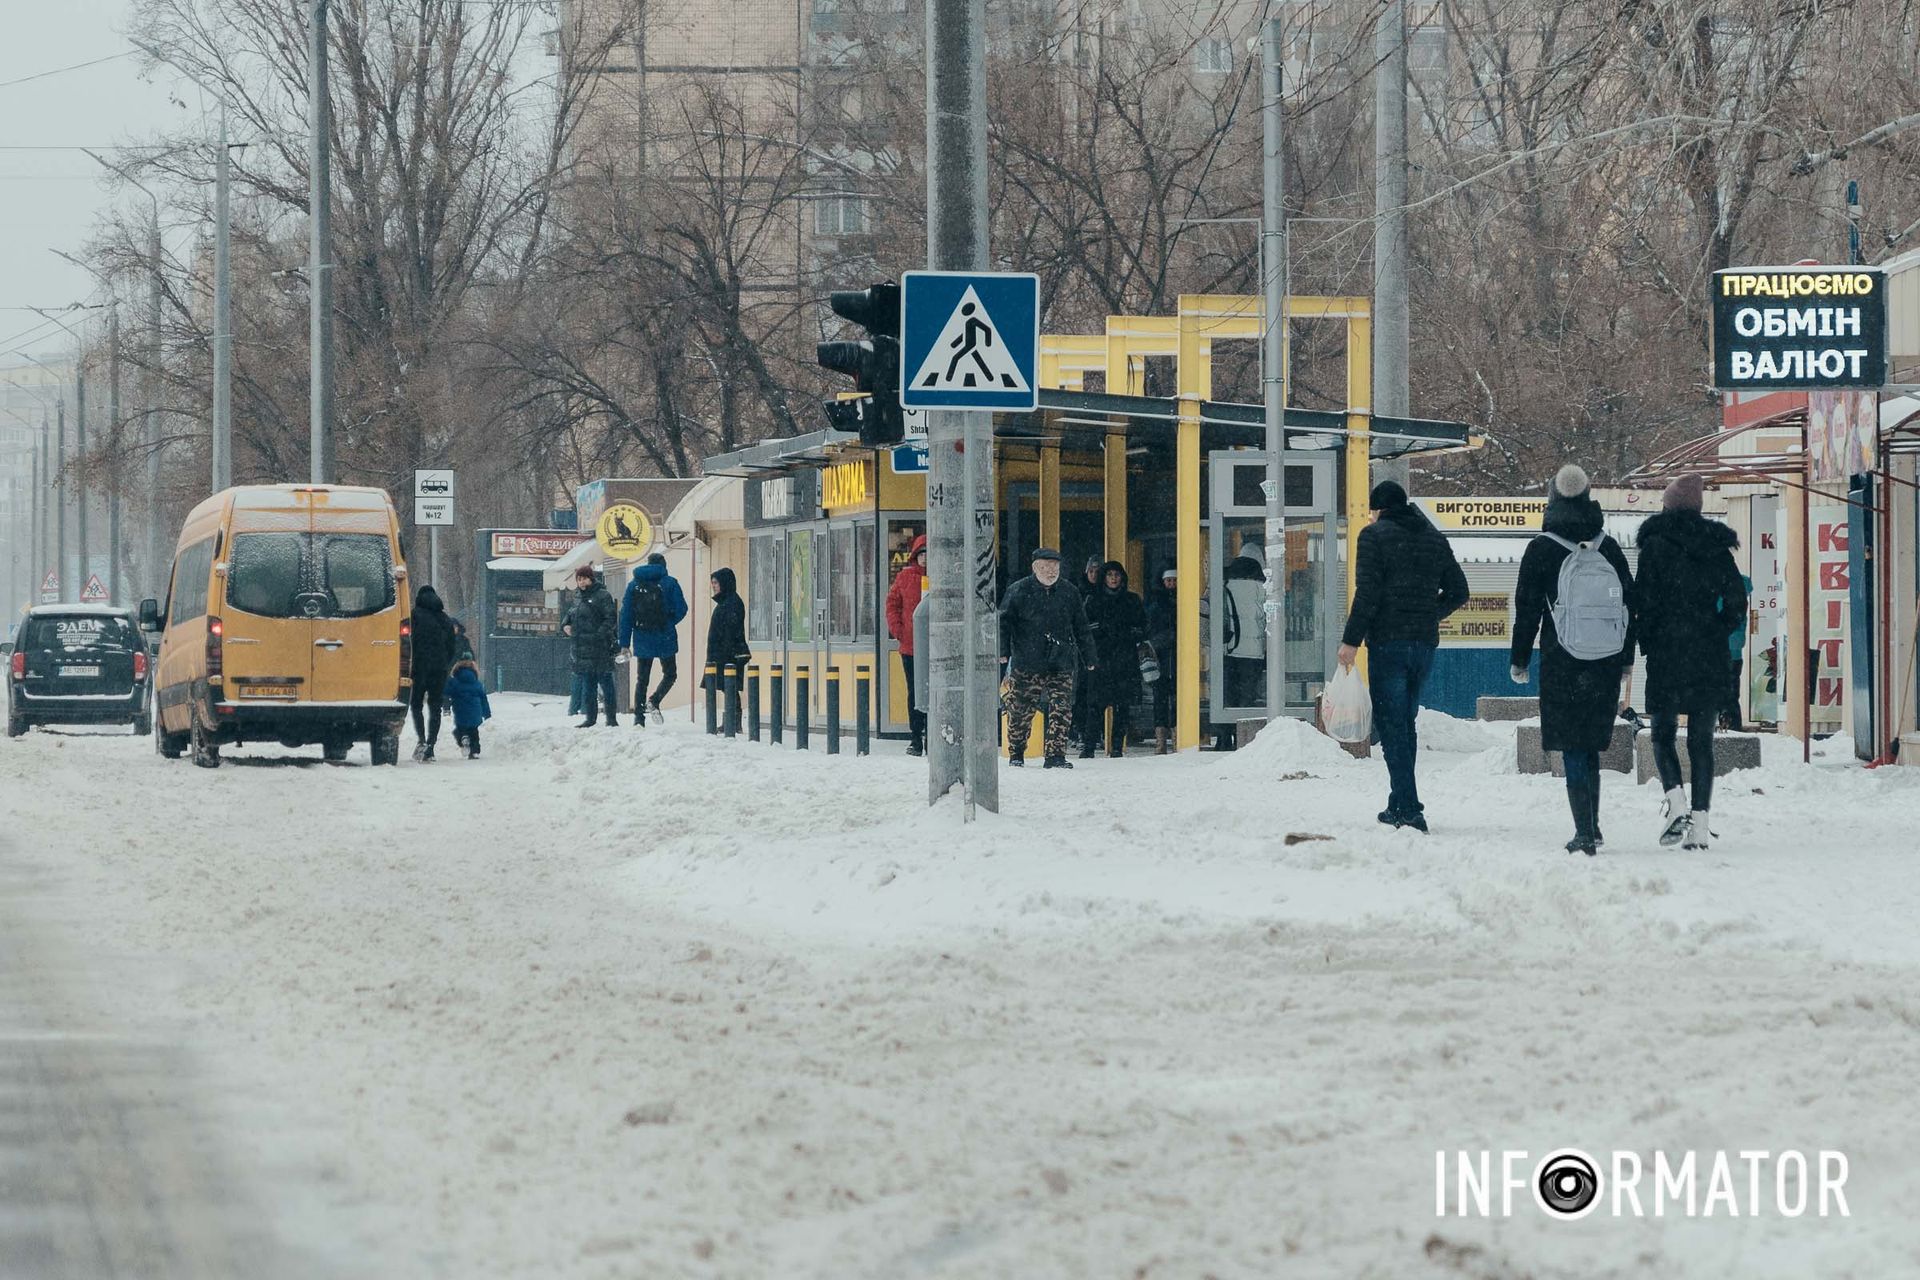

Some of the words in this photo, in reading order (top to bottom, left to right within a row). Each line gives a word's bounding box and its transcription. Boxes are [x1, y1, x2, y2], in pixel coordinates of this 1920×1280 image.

[1722, 273, 1874, 299] ПРАЦЮЄМО
[1734, 307, 1861, 337] ОБМІН
[1731, 349, 1868, 379] ВАЛЮТ
[910, 425, 928, 435] Shta
[821, 459, 866, 509] ШАУРМА
[1436, 503, 1549, 513] ВИГОТОВЛЕННЯ
[1461, 515, 1526, 526] КЛЮЧІВ
[1817, 522, 1850, 707] КВІТИ
[56, 621, 99, 633] ЭДЕМ
[1461, 619, 1505, 636] КЛЮЧЕЙ
